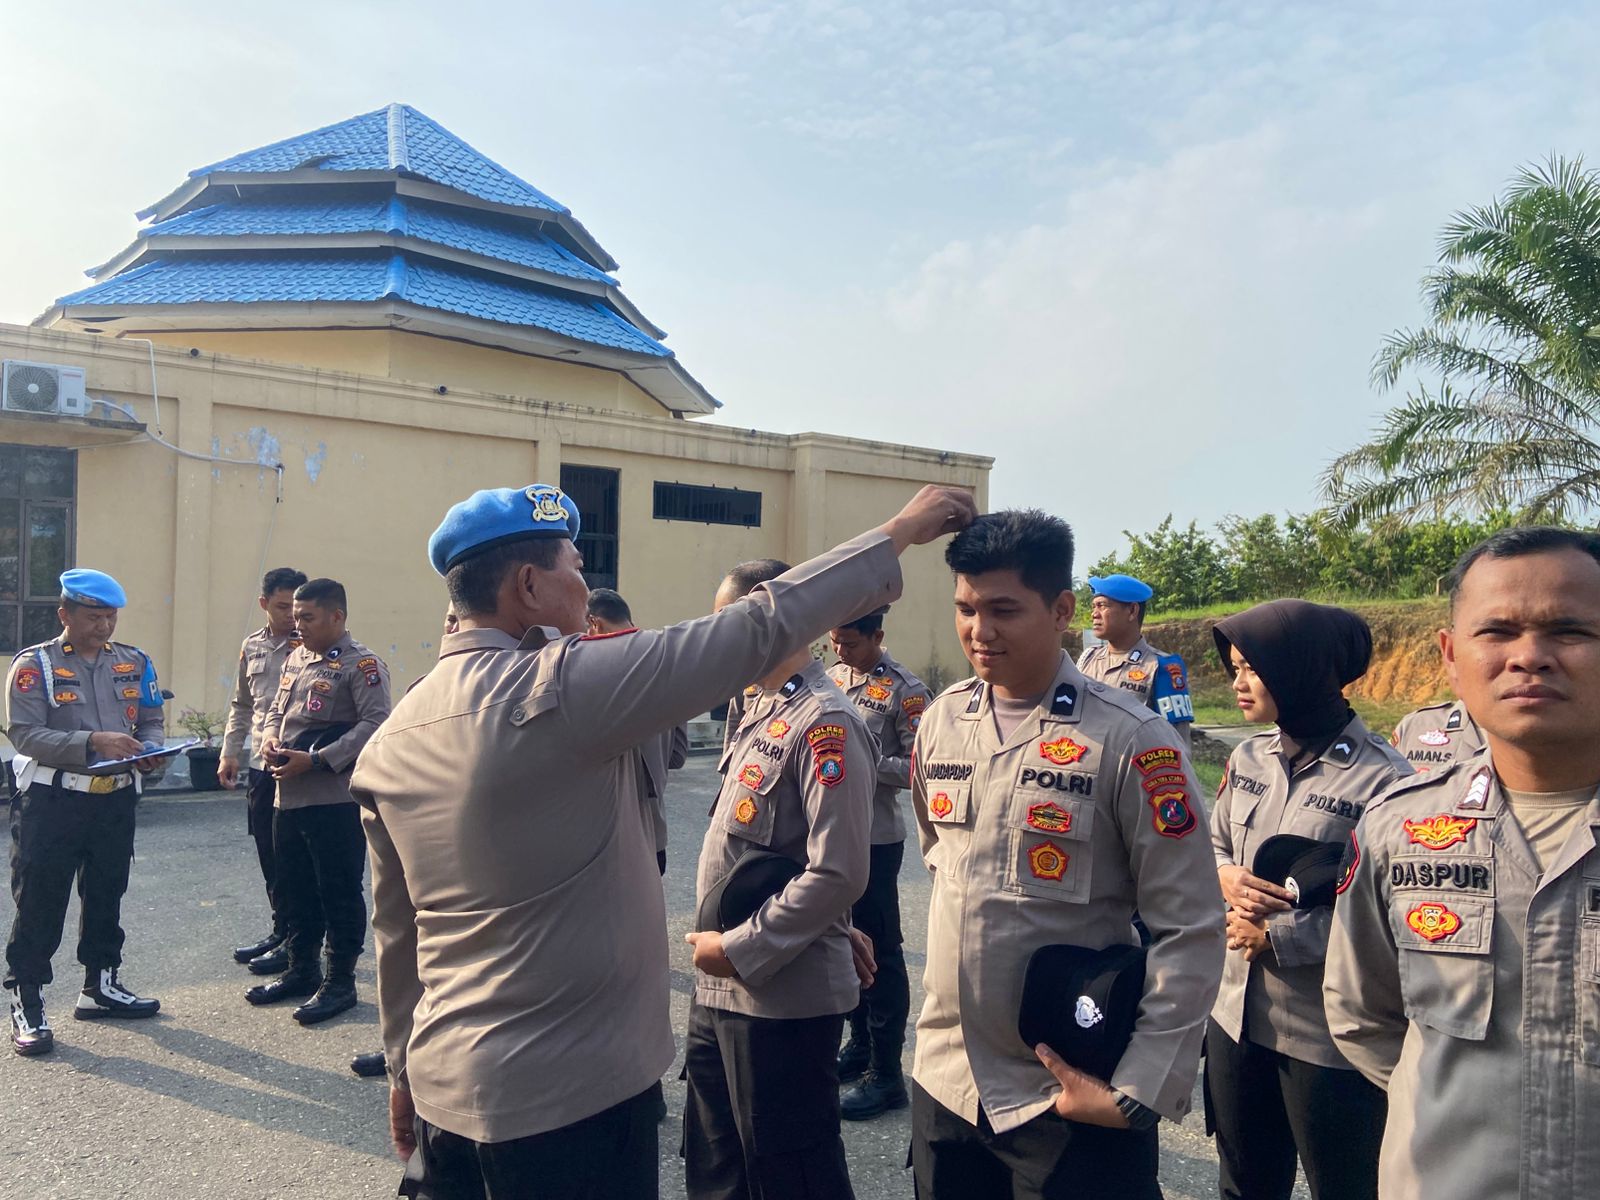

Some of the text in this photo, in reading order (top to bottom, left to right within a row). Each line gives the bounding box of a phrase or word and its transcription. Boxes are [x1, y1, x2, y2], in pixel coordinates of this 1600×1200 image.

[317, 669, 343, 680] POLRI
[1120, 681, 1147, 693] POLRI
[858, 698, 887, 713] POLRI
[751, 737, 784, 760] POLRI
[1140, 750, 1175, 765] POLRES
[1020, 768, 1093, 796] POLRI
[1303, 793, 1366, 820] POLRI
[1391, 862, 1489, 890] DASPUR
